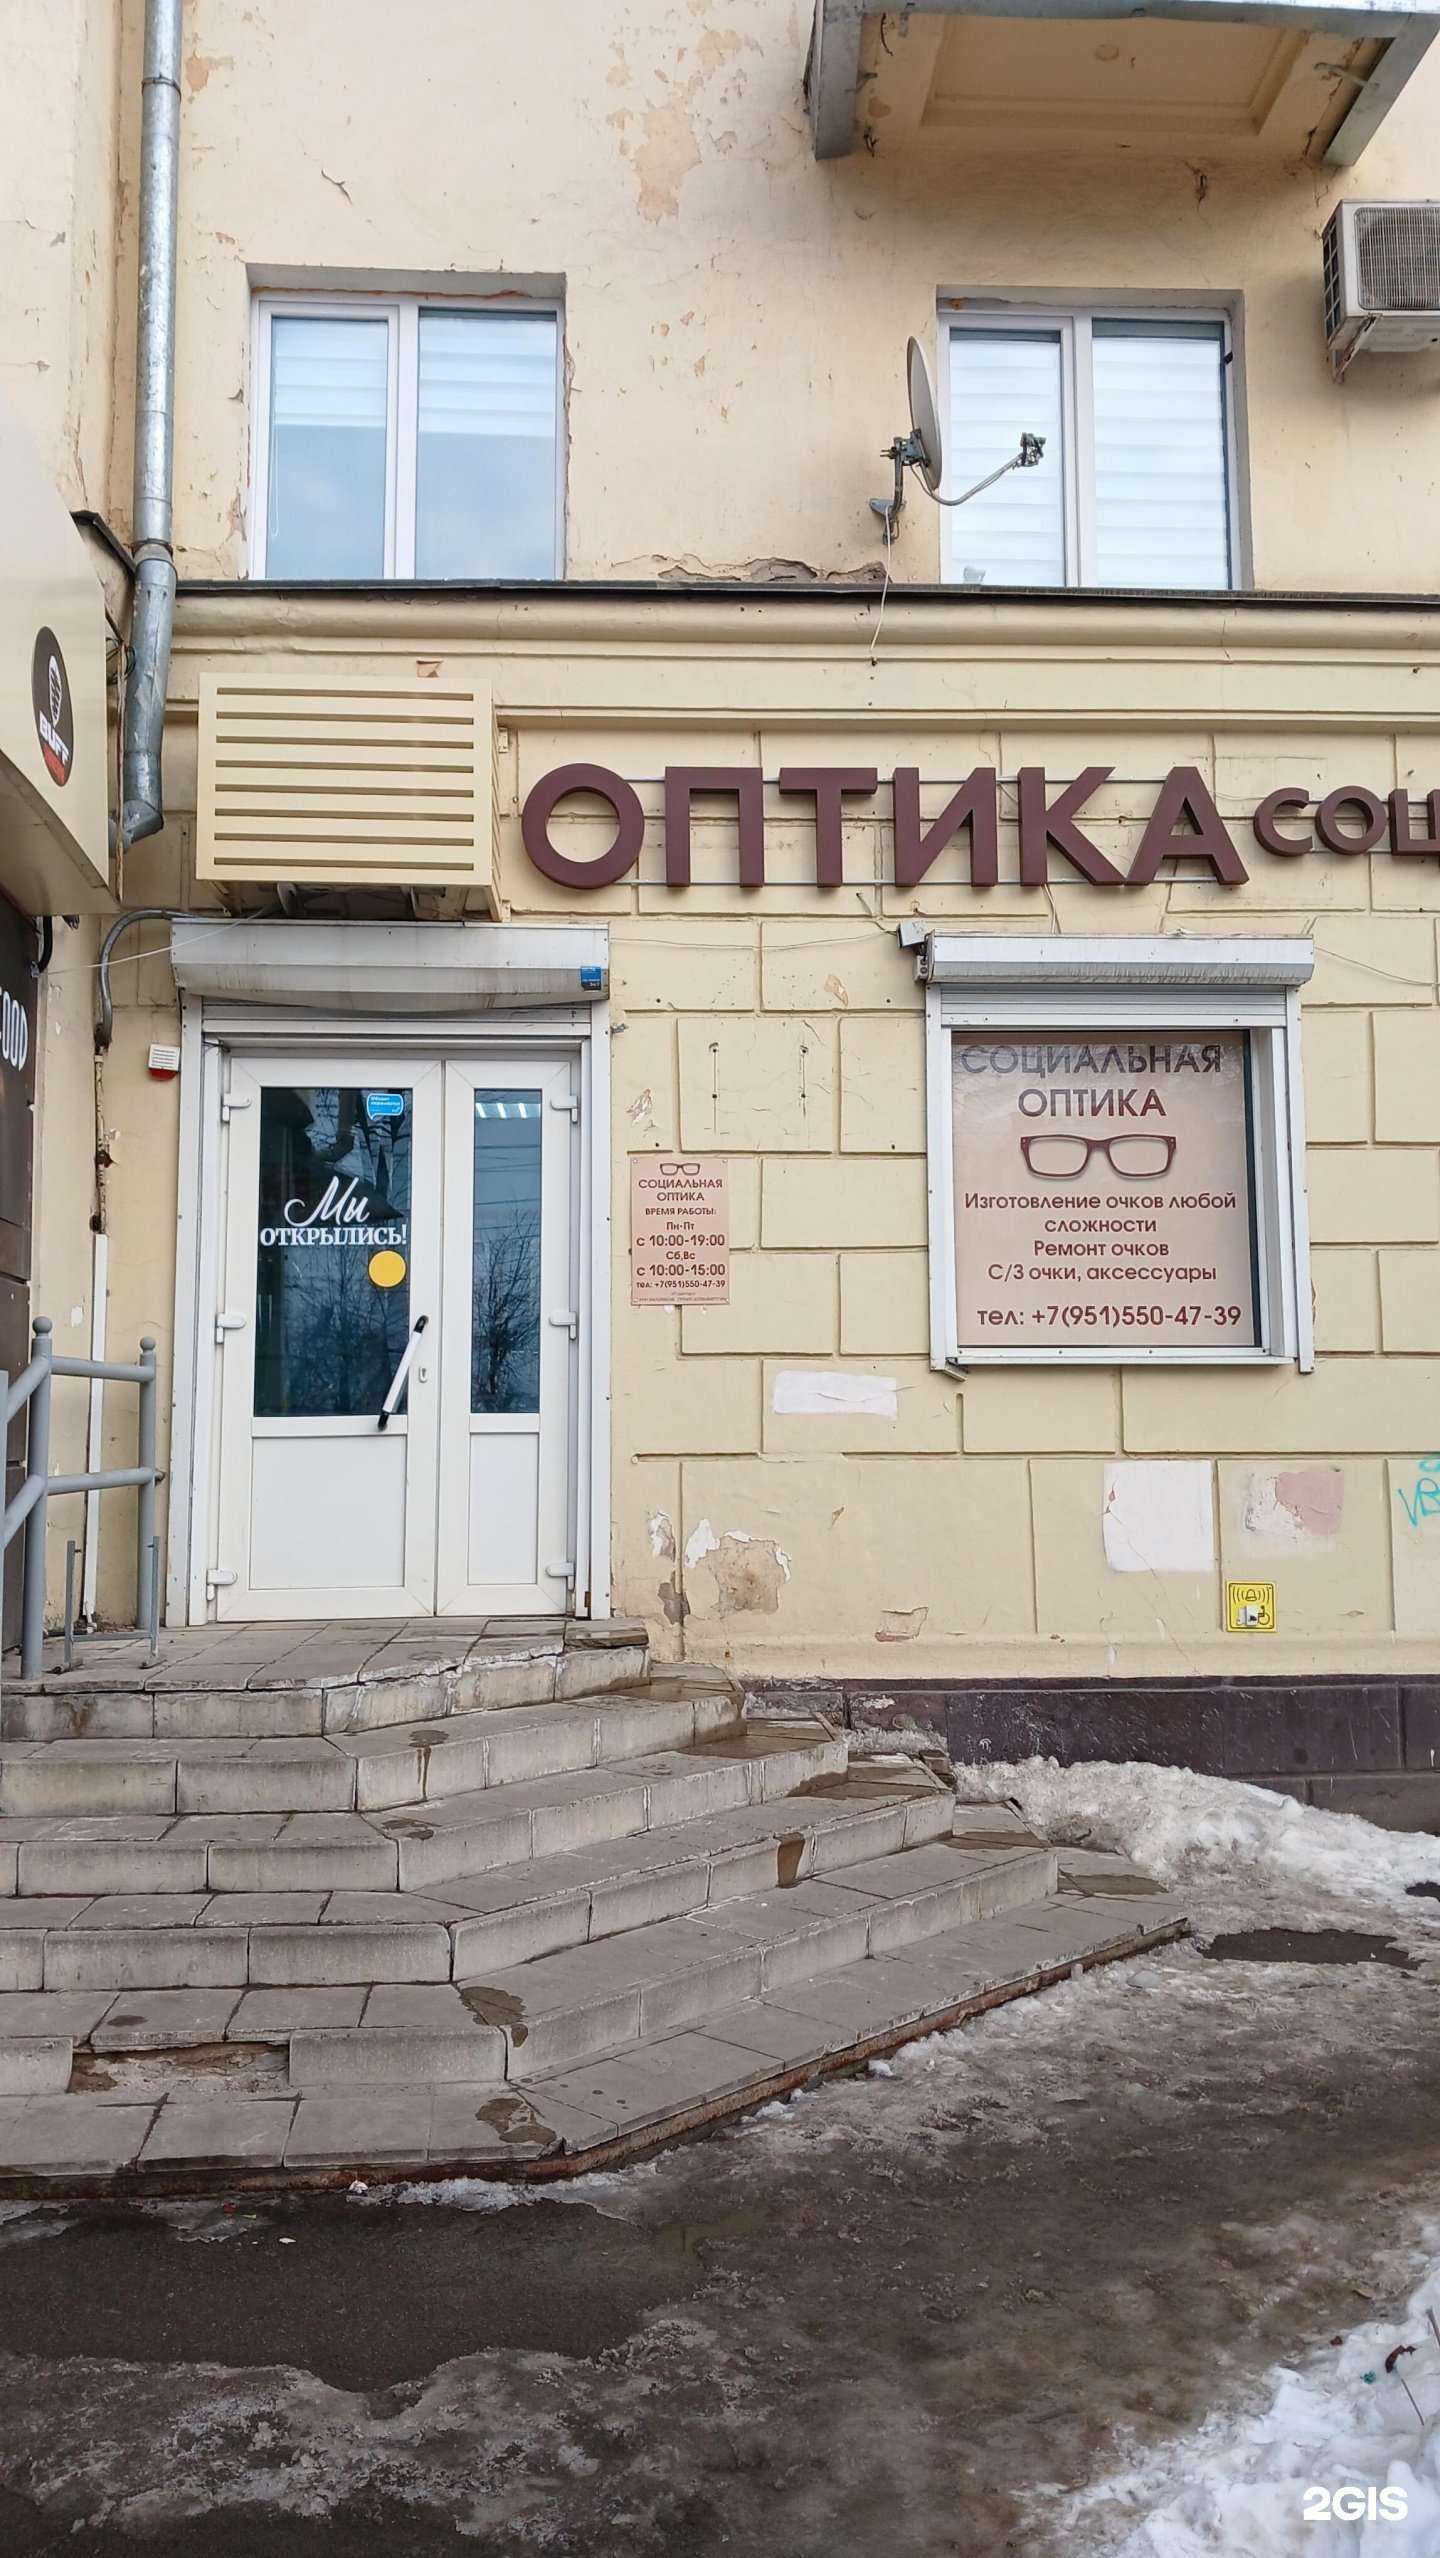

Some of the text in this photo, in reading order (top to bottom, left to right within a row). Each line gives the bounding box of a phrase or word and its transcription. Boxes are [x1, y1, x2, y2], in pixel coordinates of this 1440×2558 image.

[520, 762, 1249, 890] ОПТИКА
[0, 984, 28, 1072] OOD
[960, 1044, 1222, 1077] СОЦИАЛЬНАЯ
[1018, 1088, 1167, 1117] ОПТИКА
[638, 1179, 723, 1189] СОЦИАЛЬНАЯ
[657, 1192, 704, 1201] ОПТИКА
[965, 1192, 1237, 1209] Изготовление очков любой
[1044, 1219, 1157, 1233] сложности
[260, 1224, 407, 1246] ОТКРЫЛИСЬ!
[649, 1234, 725, 1246] 10:00-19:00
[1034, 1240, 1169, 1256] Ремонт очков
[649, 1264, 726, 1276] 10:00-15:00
[1029, 1266, 1081, 1282] очки,
[1086, 1266, 1217, 1283] аксессуары
[977, 1305, 1242, 1328] тел: +7(951)550-47-39
